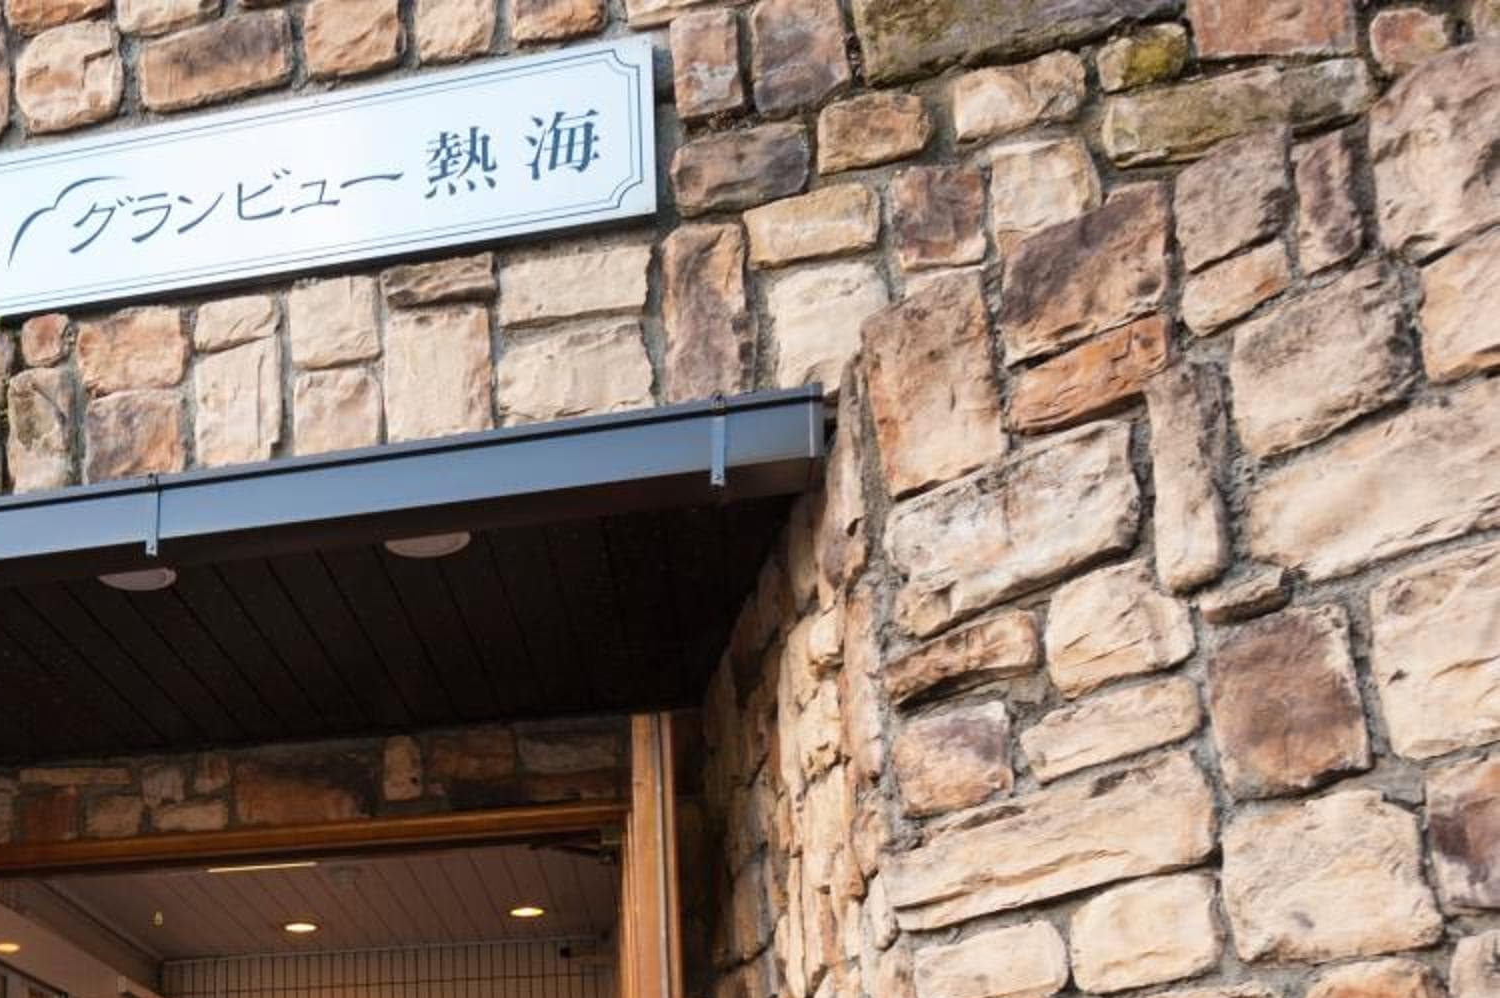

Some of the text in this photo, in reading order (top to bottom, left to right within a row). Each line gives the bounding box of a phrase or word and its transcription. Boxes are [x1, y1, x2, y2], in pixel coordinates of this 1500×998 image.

[69, 109, 601, 254] グランビュー 熱海
